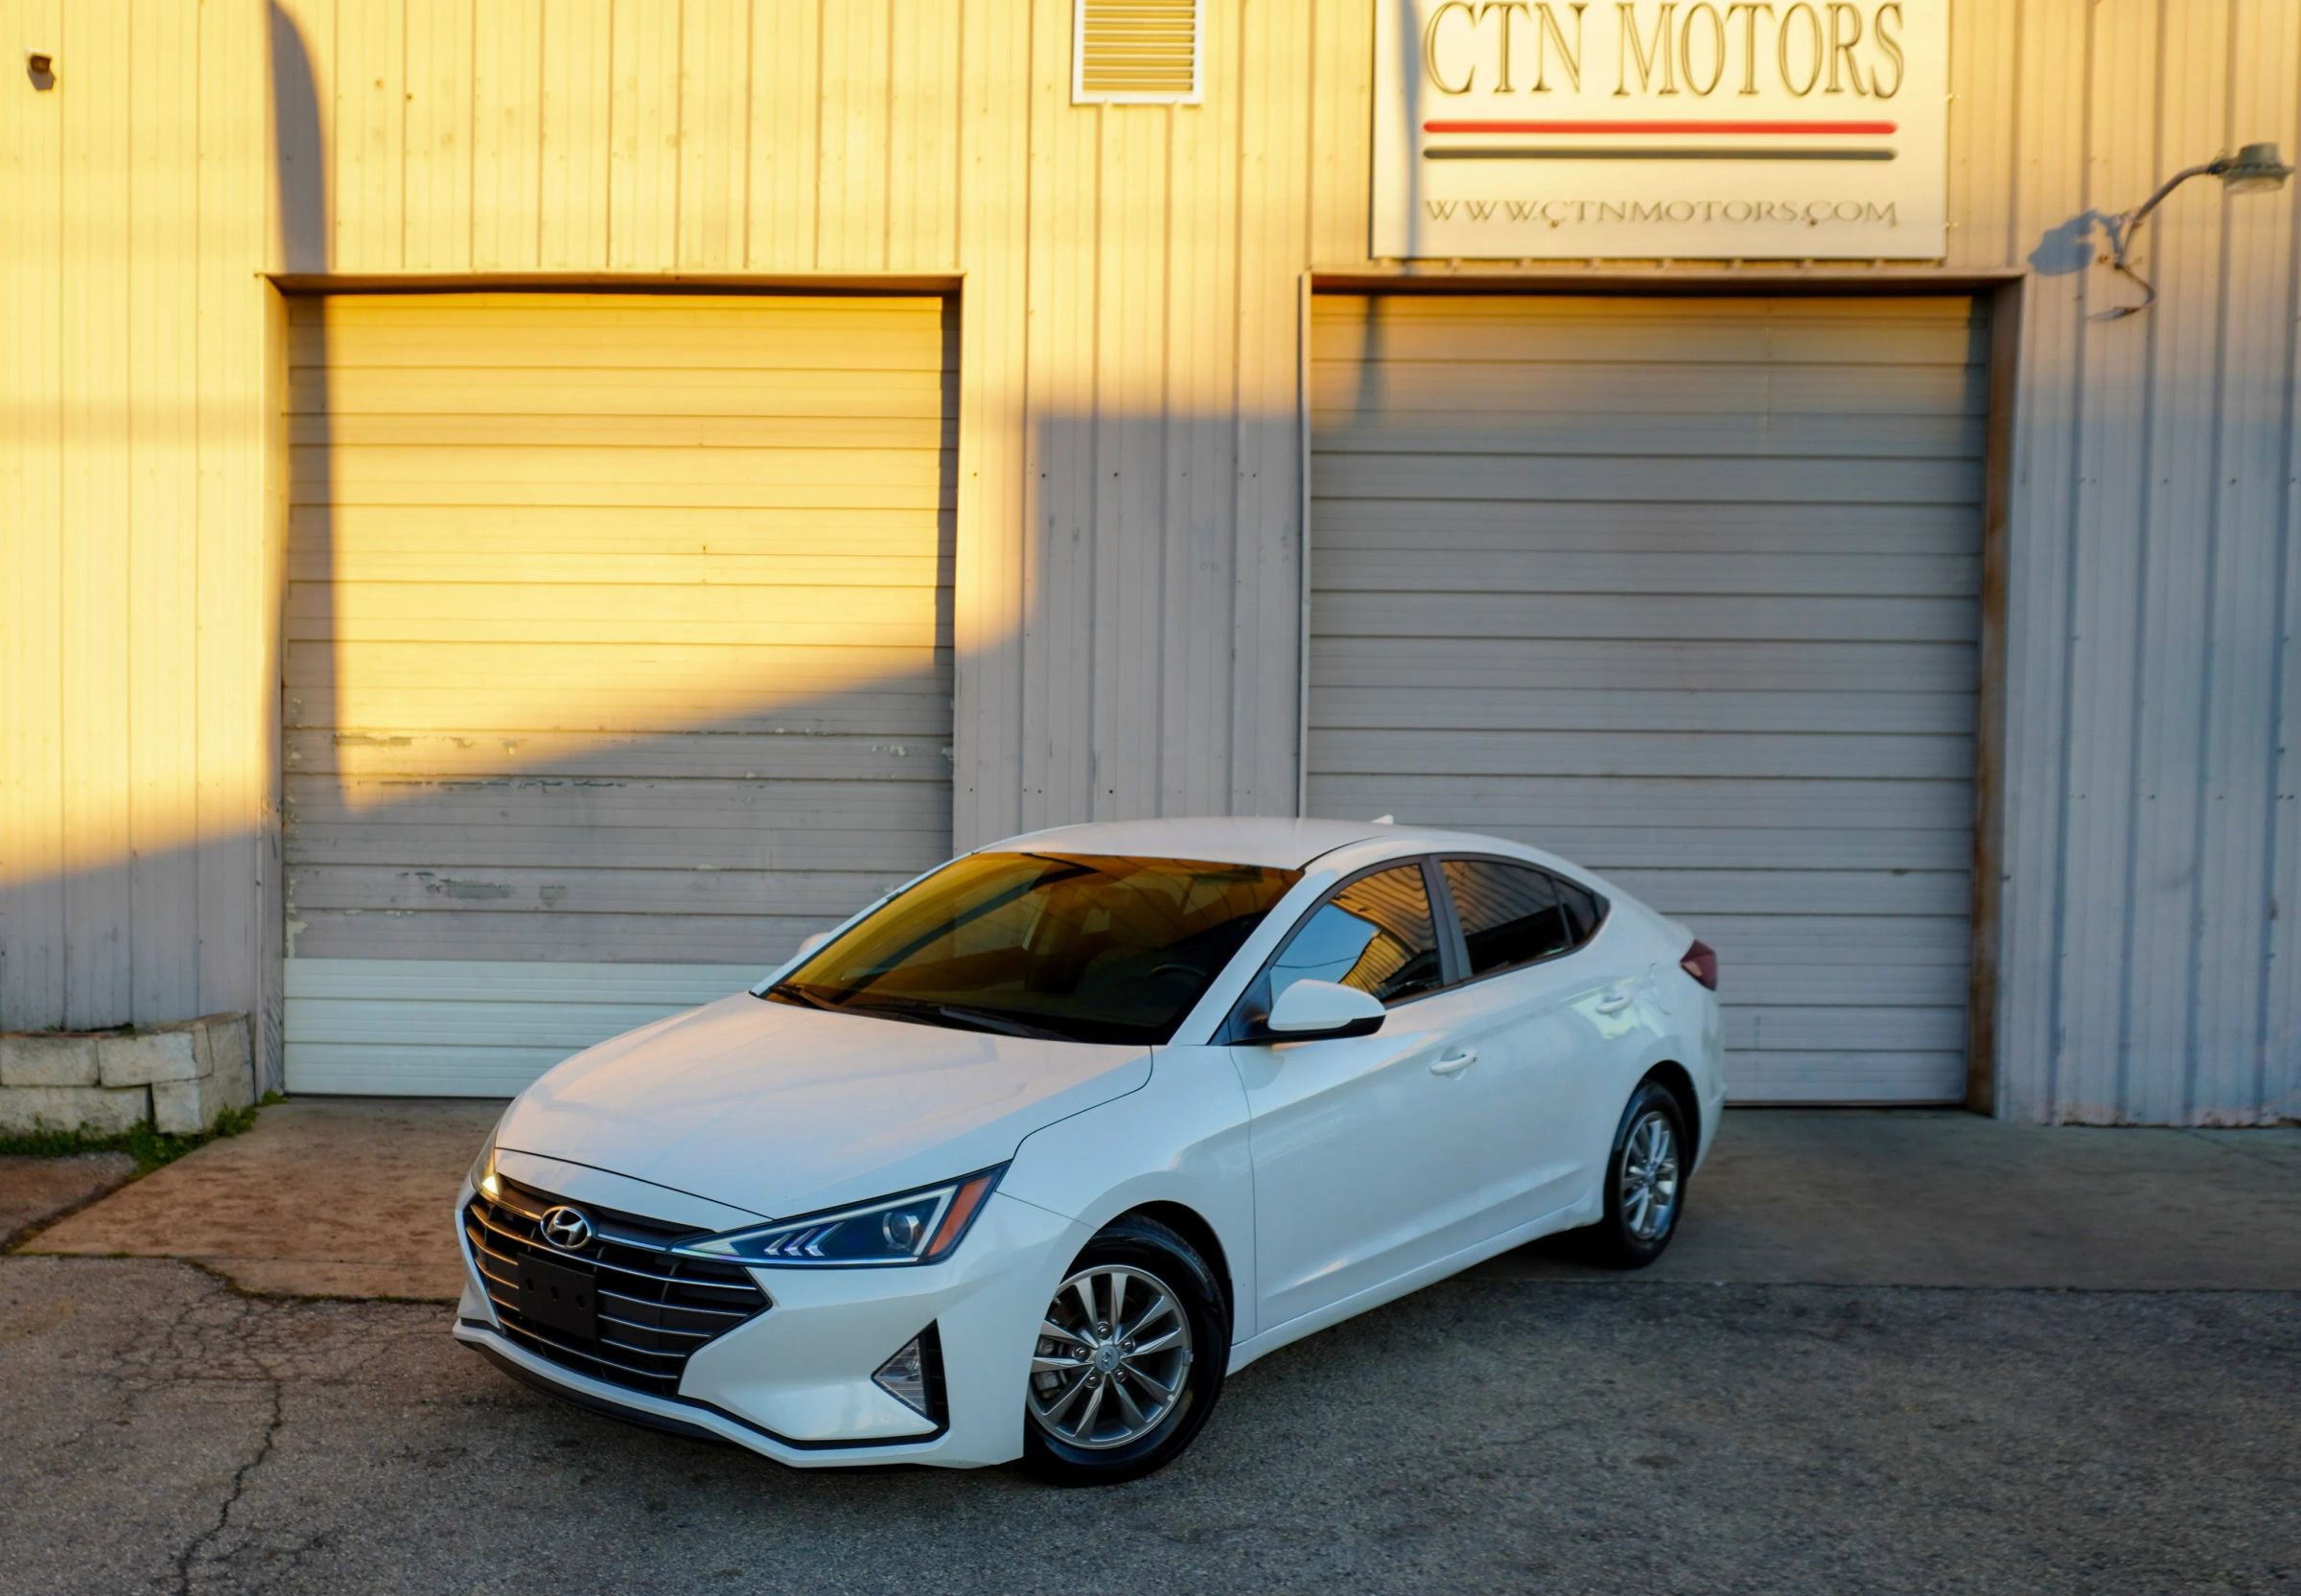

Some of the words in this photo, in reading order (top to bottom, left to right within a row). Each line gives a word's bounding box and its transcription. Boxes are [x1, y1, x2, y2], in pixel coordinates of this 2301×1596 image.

[1424, 1, 1589, 95] CTN
[1613, 1, 1905, 98] MOTORS
[1425, 199, 1896, 224] WWW.CTNMOTORS.COM
